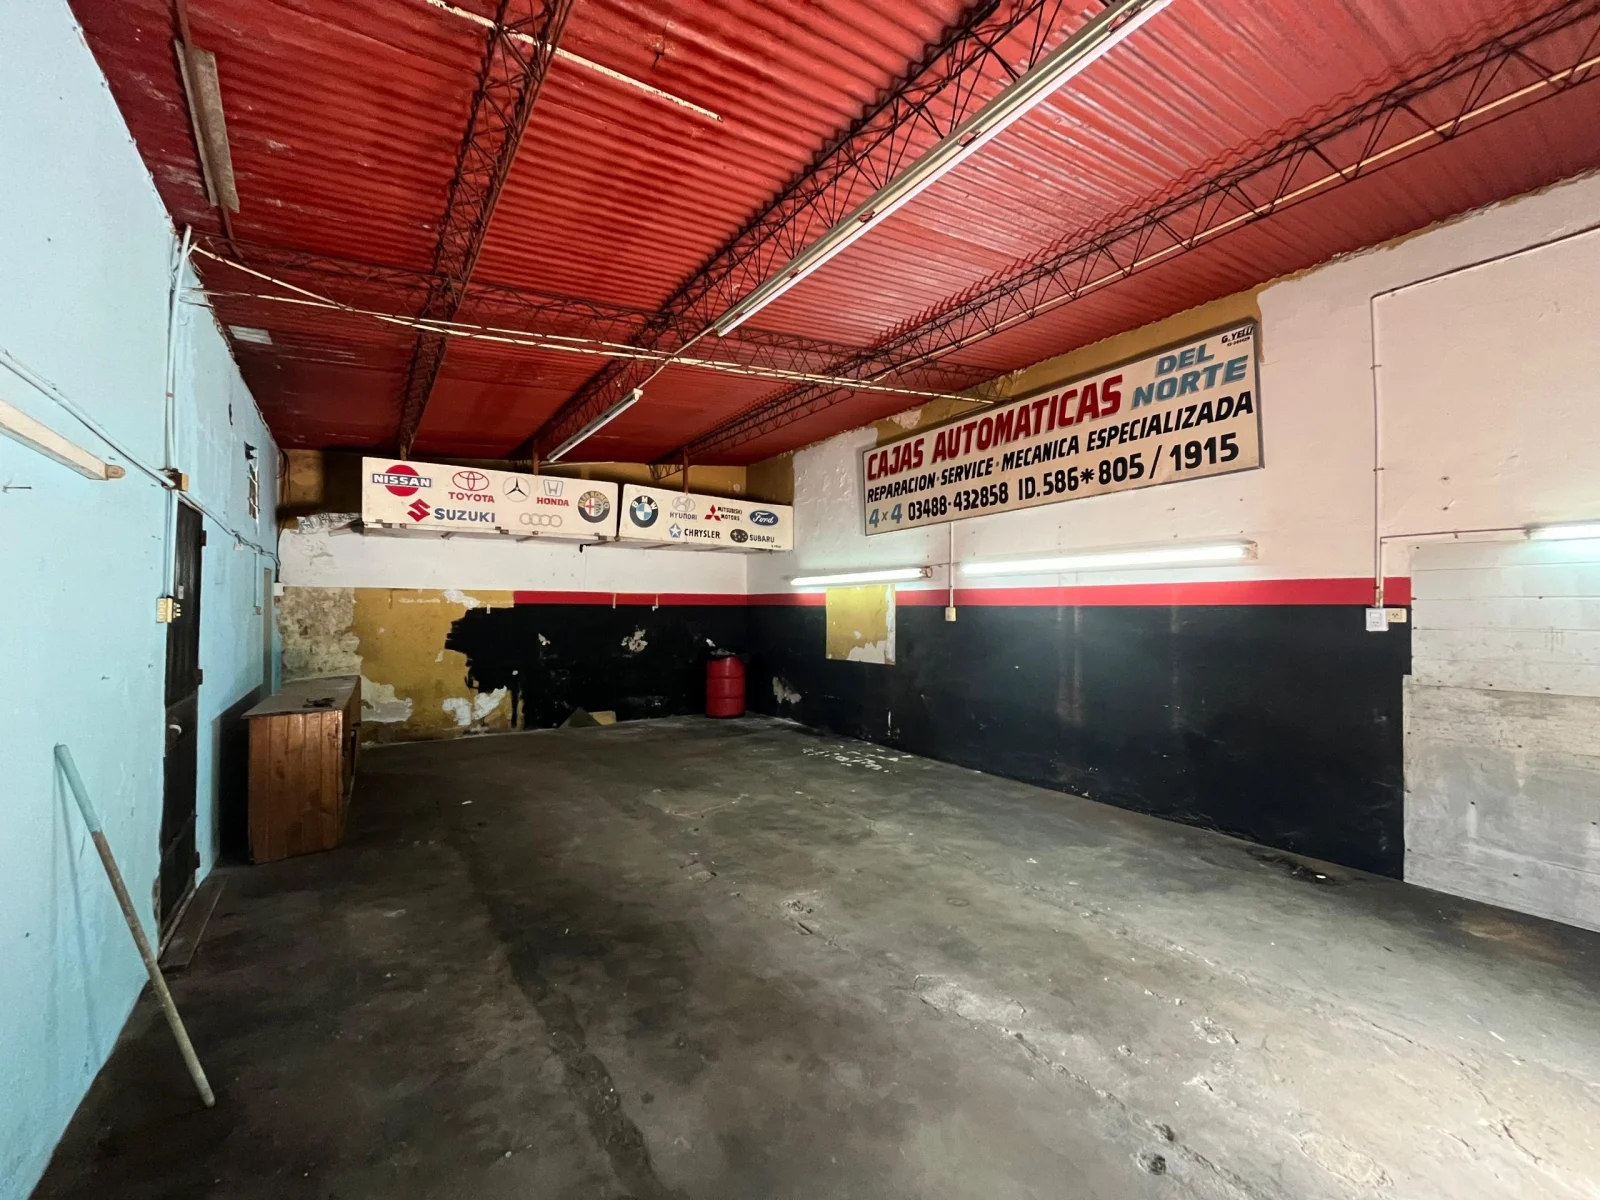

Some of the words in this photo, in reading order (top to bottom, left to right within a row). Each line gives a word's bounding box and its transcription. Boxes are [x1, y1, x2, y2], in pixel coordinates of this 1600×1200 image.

[1155, 343, 1215, 377] DEL
[1131, 355, 1249, 410] NORTE
[1086, 390, 1254, 452] ESPECIALIZADA
[867, 437, 925, 483] CAJAS
[930, 374, 1123, 466] AUTOMATICAS
[372, 473, 432, 488] NISSAN
[448, 491, 495, 504] TOYOTA
[536, 496, 570, 507] HONDA
[631, 496, 658, 511] BMW
[433, 507, 496, 523] SUZUKI
[717, 506, 743, 516] MITSUBISHI
[720, 513, 741, 522] MOTORS
[752, 511, 775, 524] Ford
[684, 528, 721, 540] CHRYSLER
[749, 534, 775, 544] SUBARU
